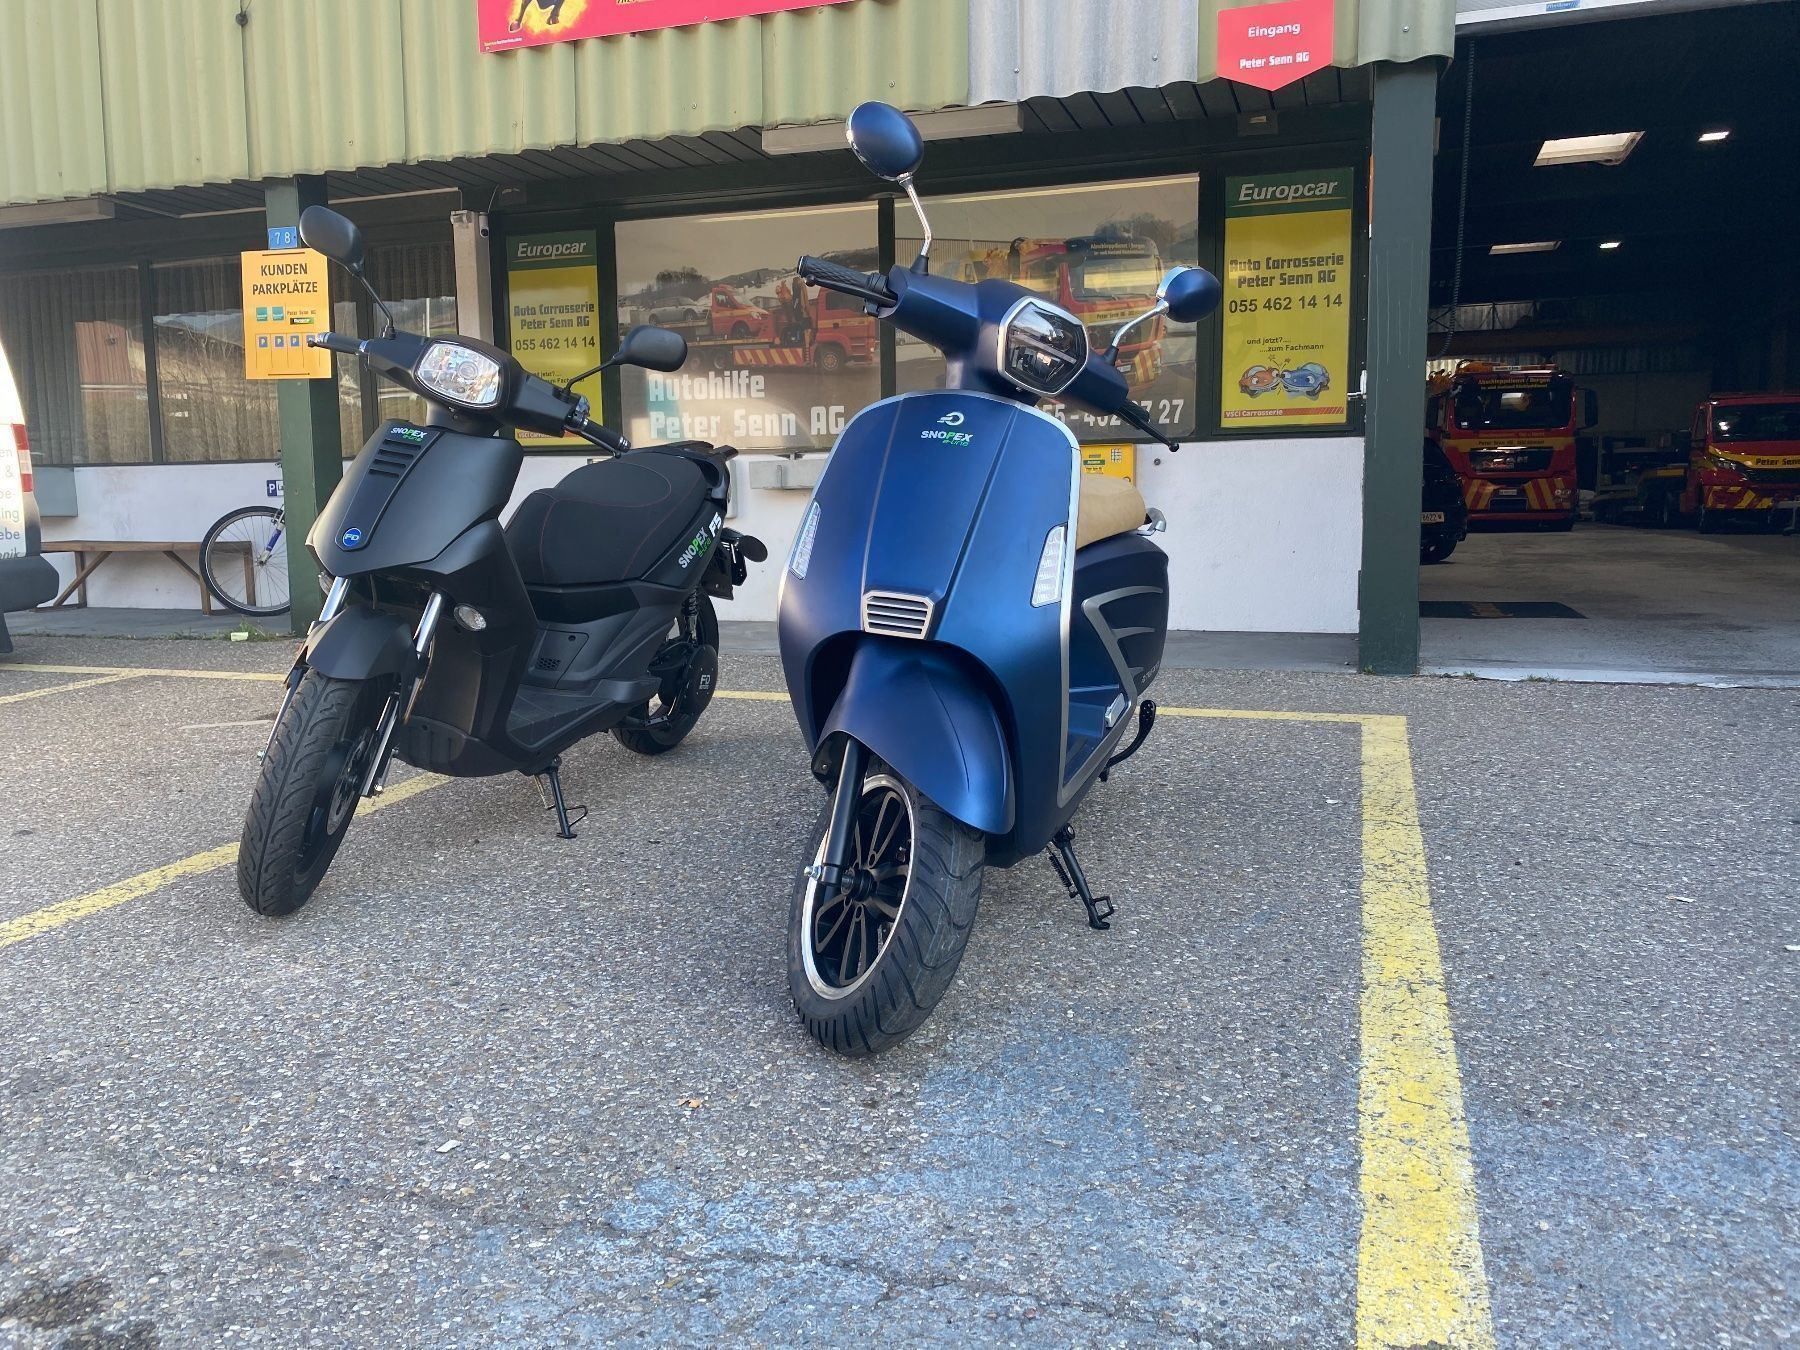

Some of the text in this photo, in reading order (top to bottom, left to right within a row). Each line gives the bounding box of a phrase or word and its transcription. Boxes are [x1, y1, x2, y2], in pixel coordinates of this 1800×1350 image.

[1248, 24, 1301, 38] Eingang
[1239, 51, 1310, 70] Peter Senn AG
[1238, 181, 1339, 203] Europcar
[275, 231, 291, 244] 78
[517, 241, 587, 259] Europcar
[260, 263, 308, 277] KUNDEN
[1229, 253, 1344, 272] Auto Carrosserie
[1238, 269, 1336, 288] Peter Senn AG
[252, 280, 318, 296] PARKPLÄTZE
[514, 301, 595, 317] Auto Carrosserie
[1228, 293, 1343, 314] 055 462 14 14
[520, 316, 590, 330] Peter Senn AG
[515, 336, 596, 350] 055 462 14 14
[1285, 344, 1324, 352] Fachmann
[649, 370, 765, 401] Autohilfe
[1158, 399, 1184, 425] 27
[1242, 409, 1283, 417] Carrosserie
[650, 405, 845, 439] Peter Senn AG
[390, 427, 428, 439] SNOPEX
[920, 430, 974, 442] SNOPEX
[344, 533, 360, 541] FD
[678, 526, 709, 569] SNOPEX
